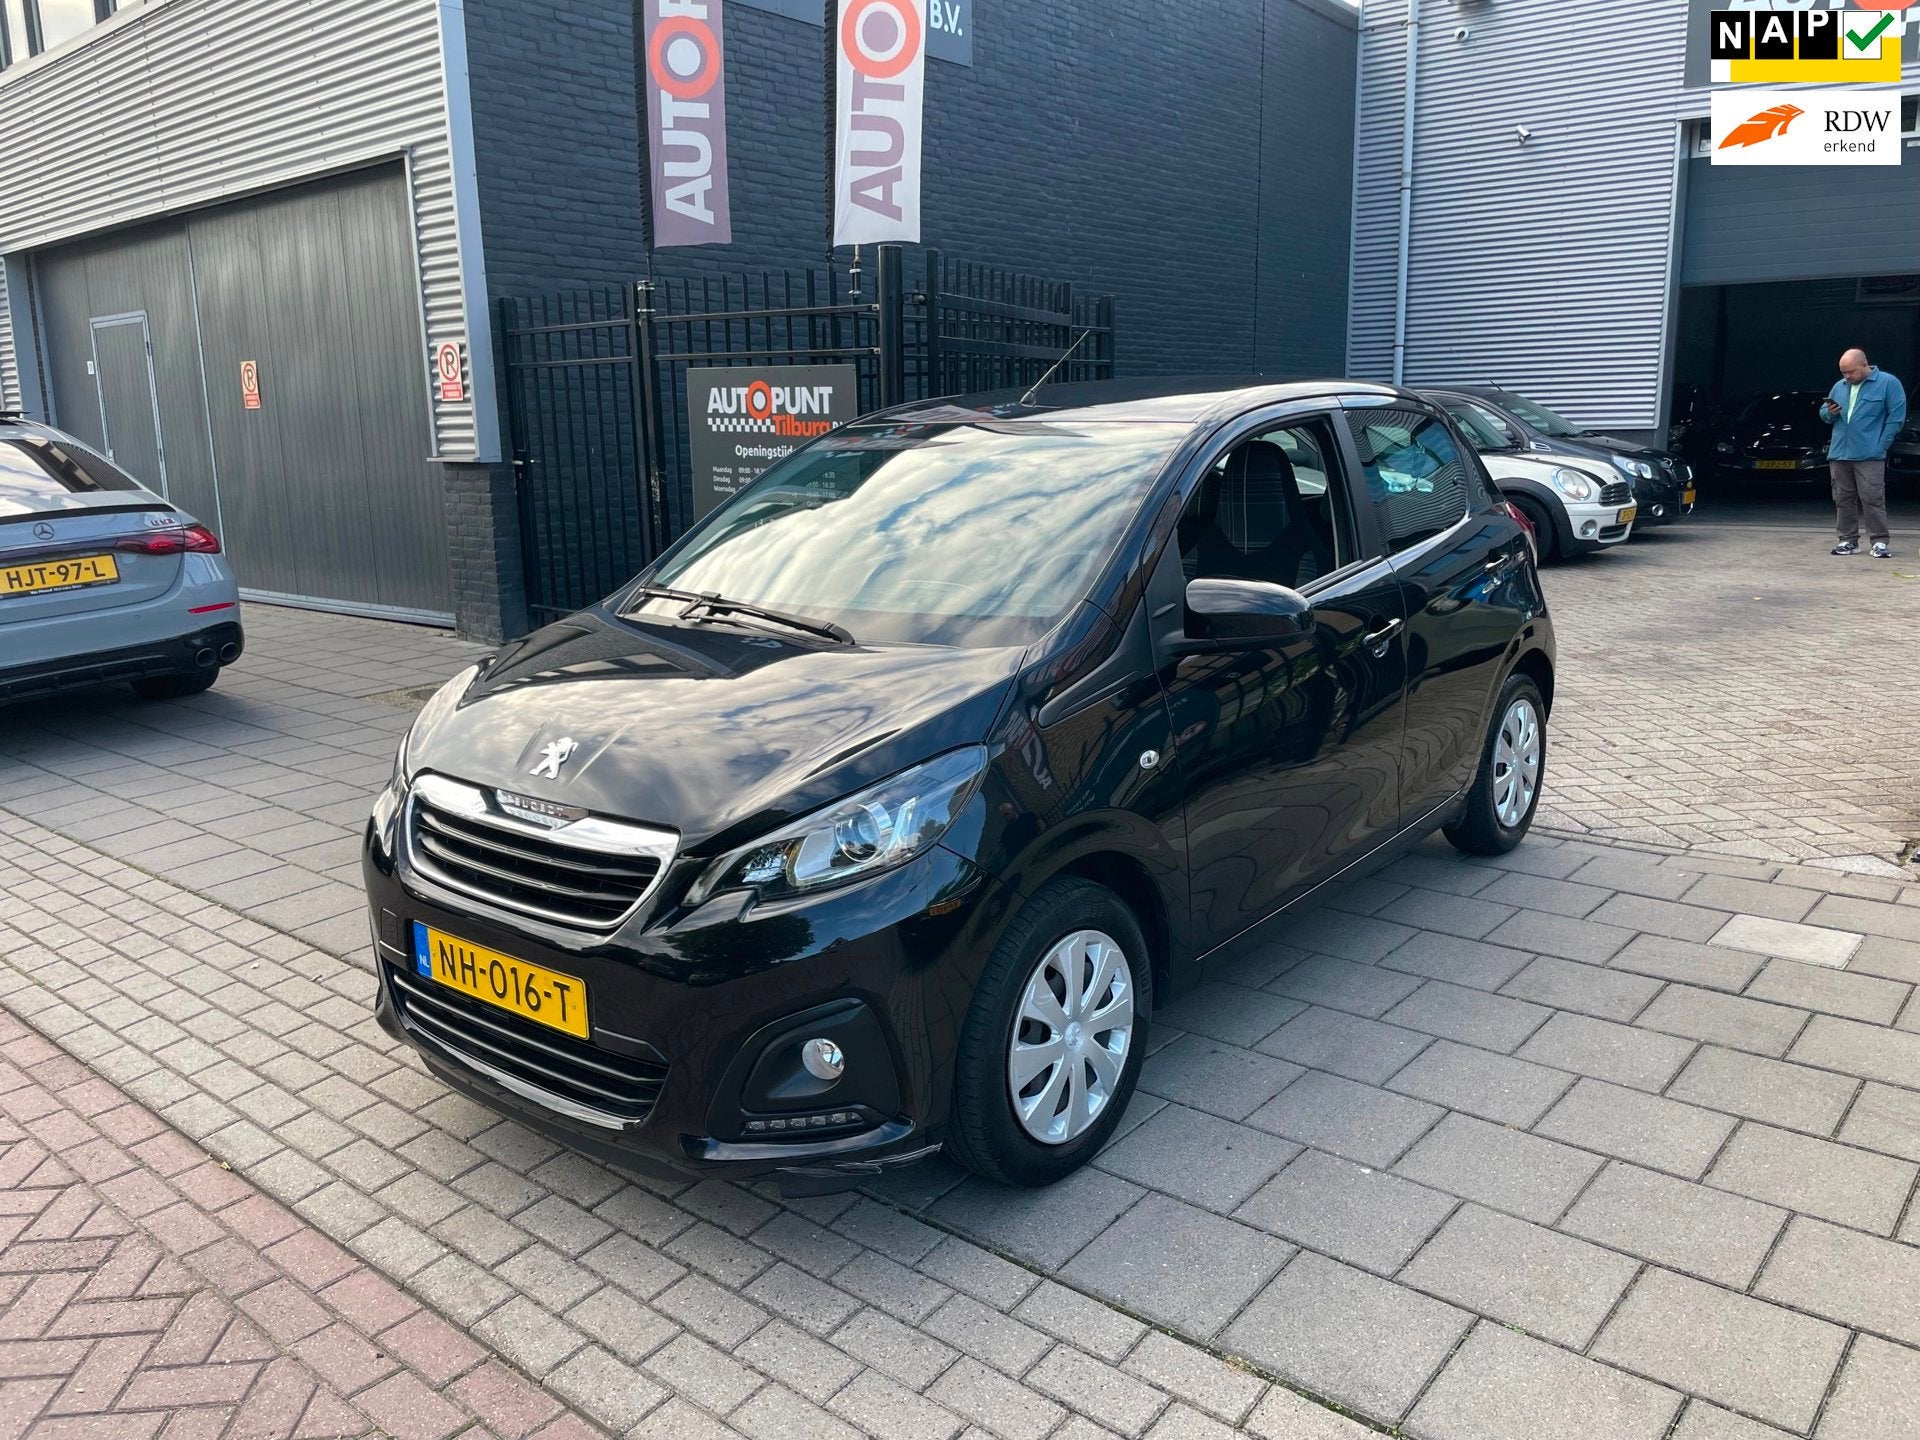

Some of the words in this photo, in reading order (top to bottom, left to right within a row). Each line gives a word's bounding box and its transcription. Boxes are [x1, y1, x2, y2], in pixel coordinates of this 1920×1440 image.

[929, 0, 964, 36] B.V.
[707, 380, 833, 420] AUTOPUNT
[6, 560, 107, 589] HJT-97-L
[418, 953, 430, 968] NL
[438, 939, 571, 1023] NH-016-T
